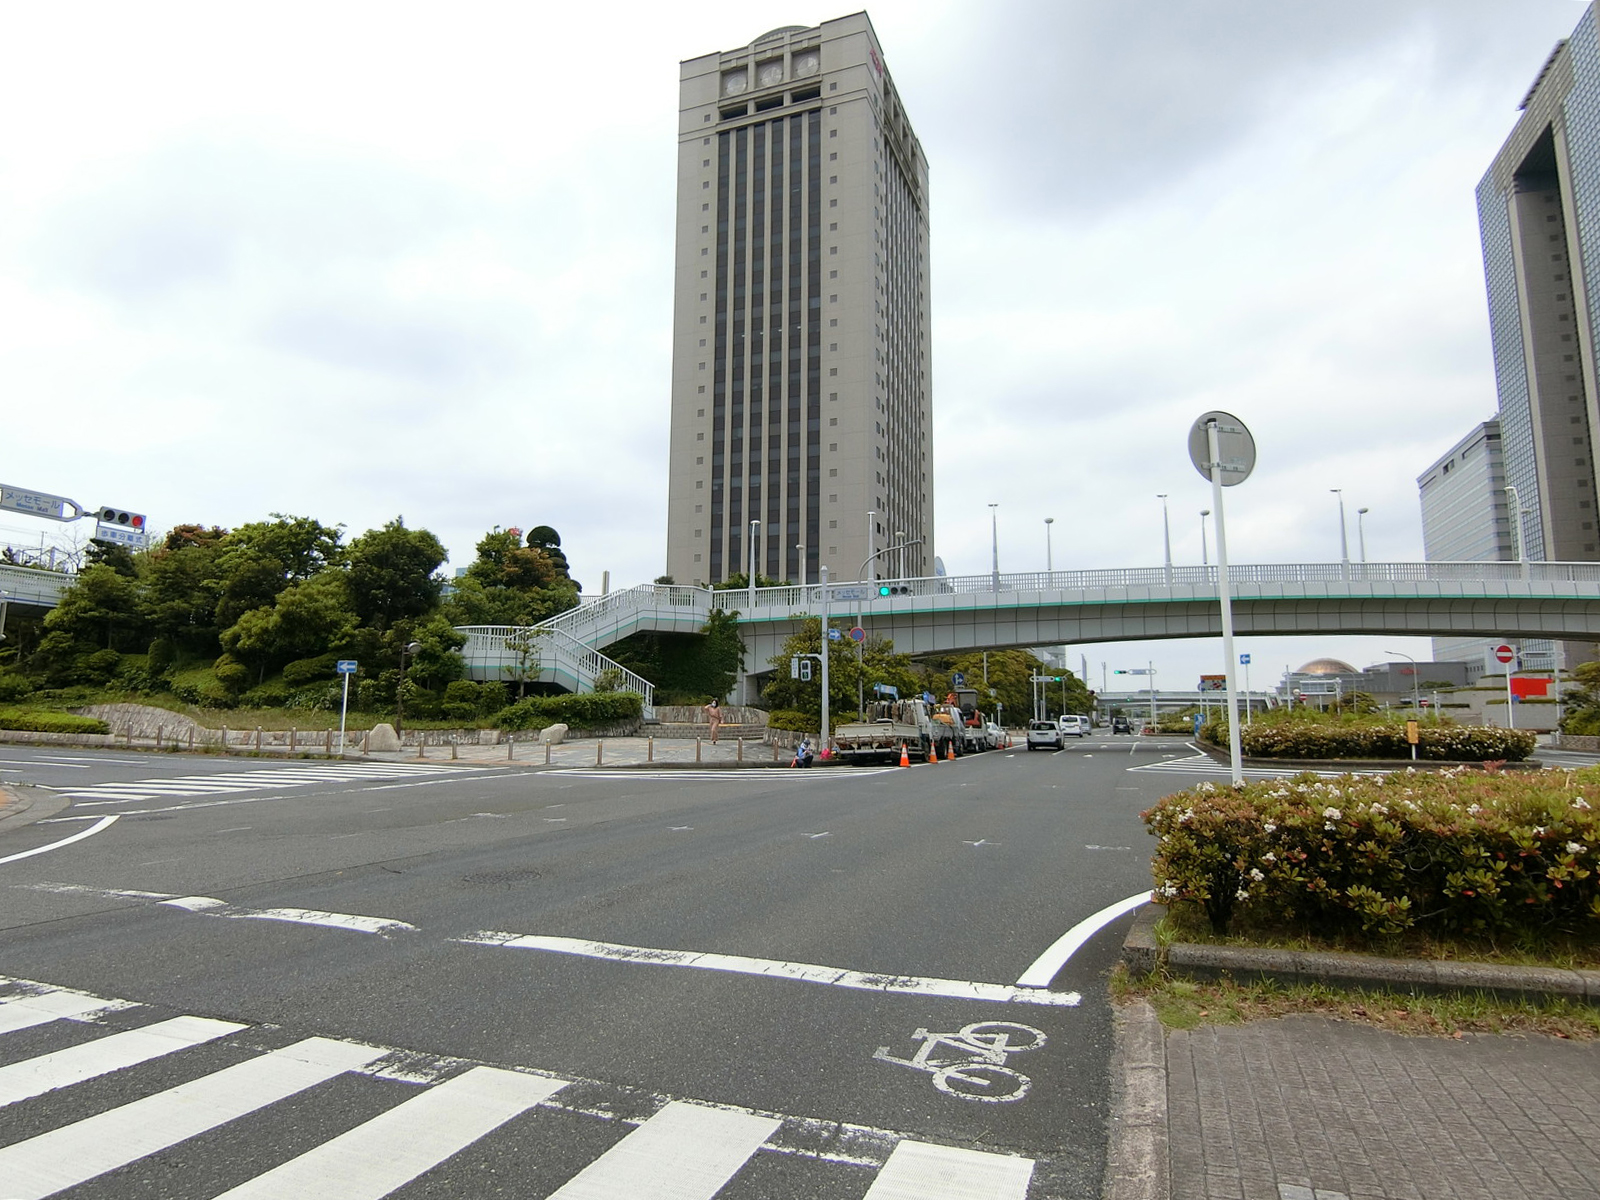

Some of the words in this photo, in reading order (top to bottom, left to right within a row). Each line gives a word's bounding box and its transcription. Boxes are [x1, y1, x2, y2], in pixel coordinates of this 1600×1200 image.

[6, 492, 60, 509] メッセモール
[101, 529, 143, 544] 歩車分離式
